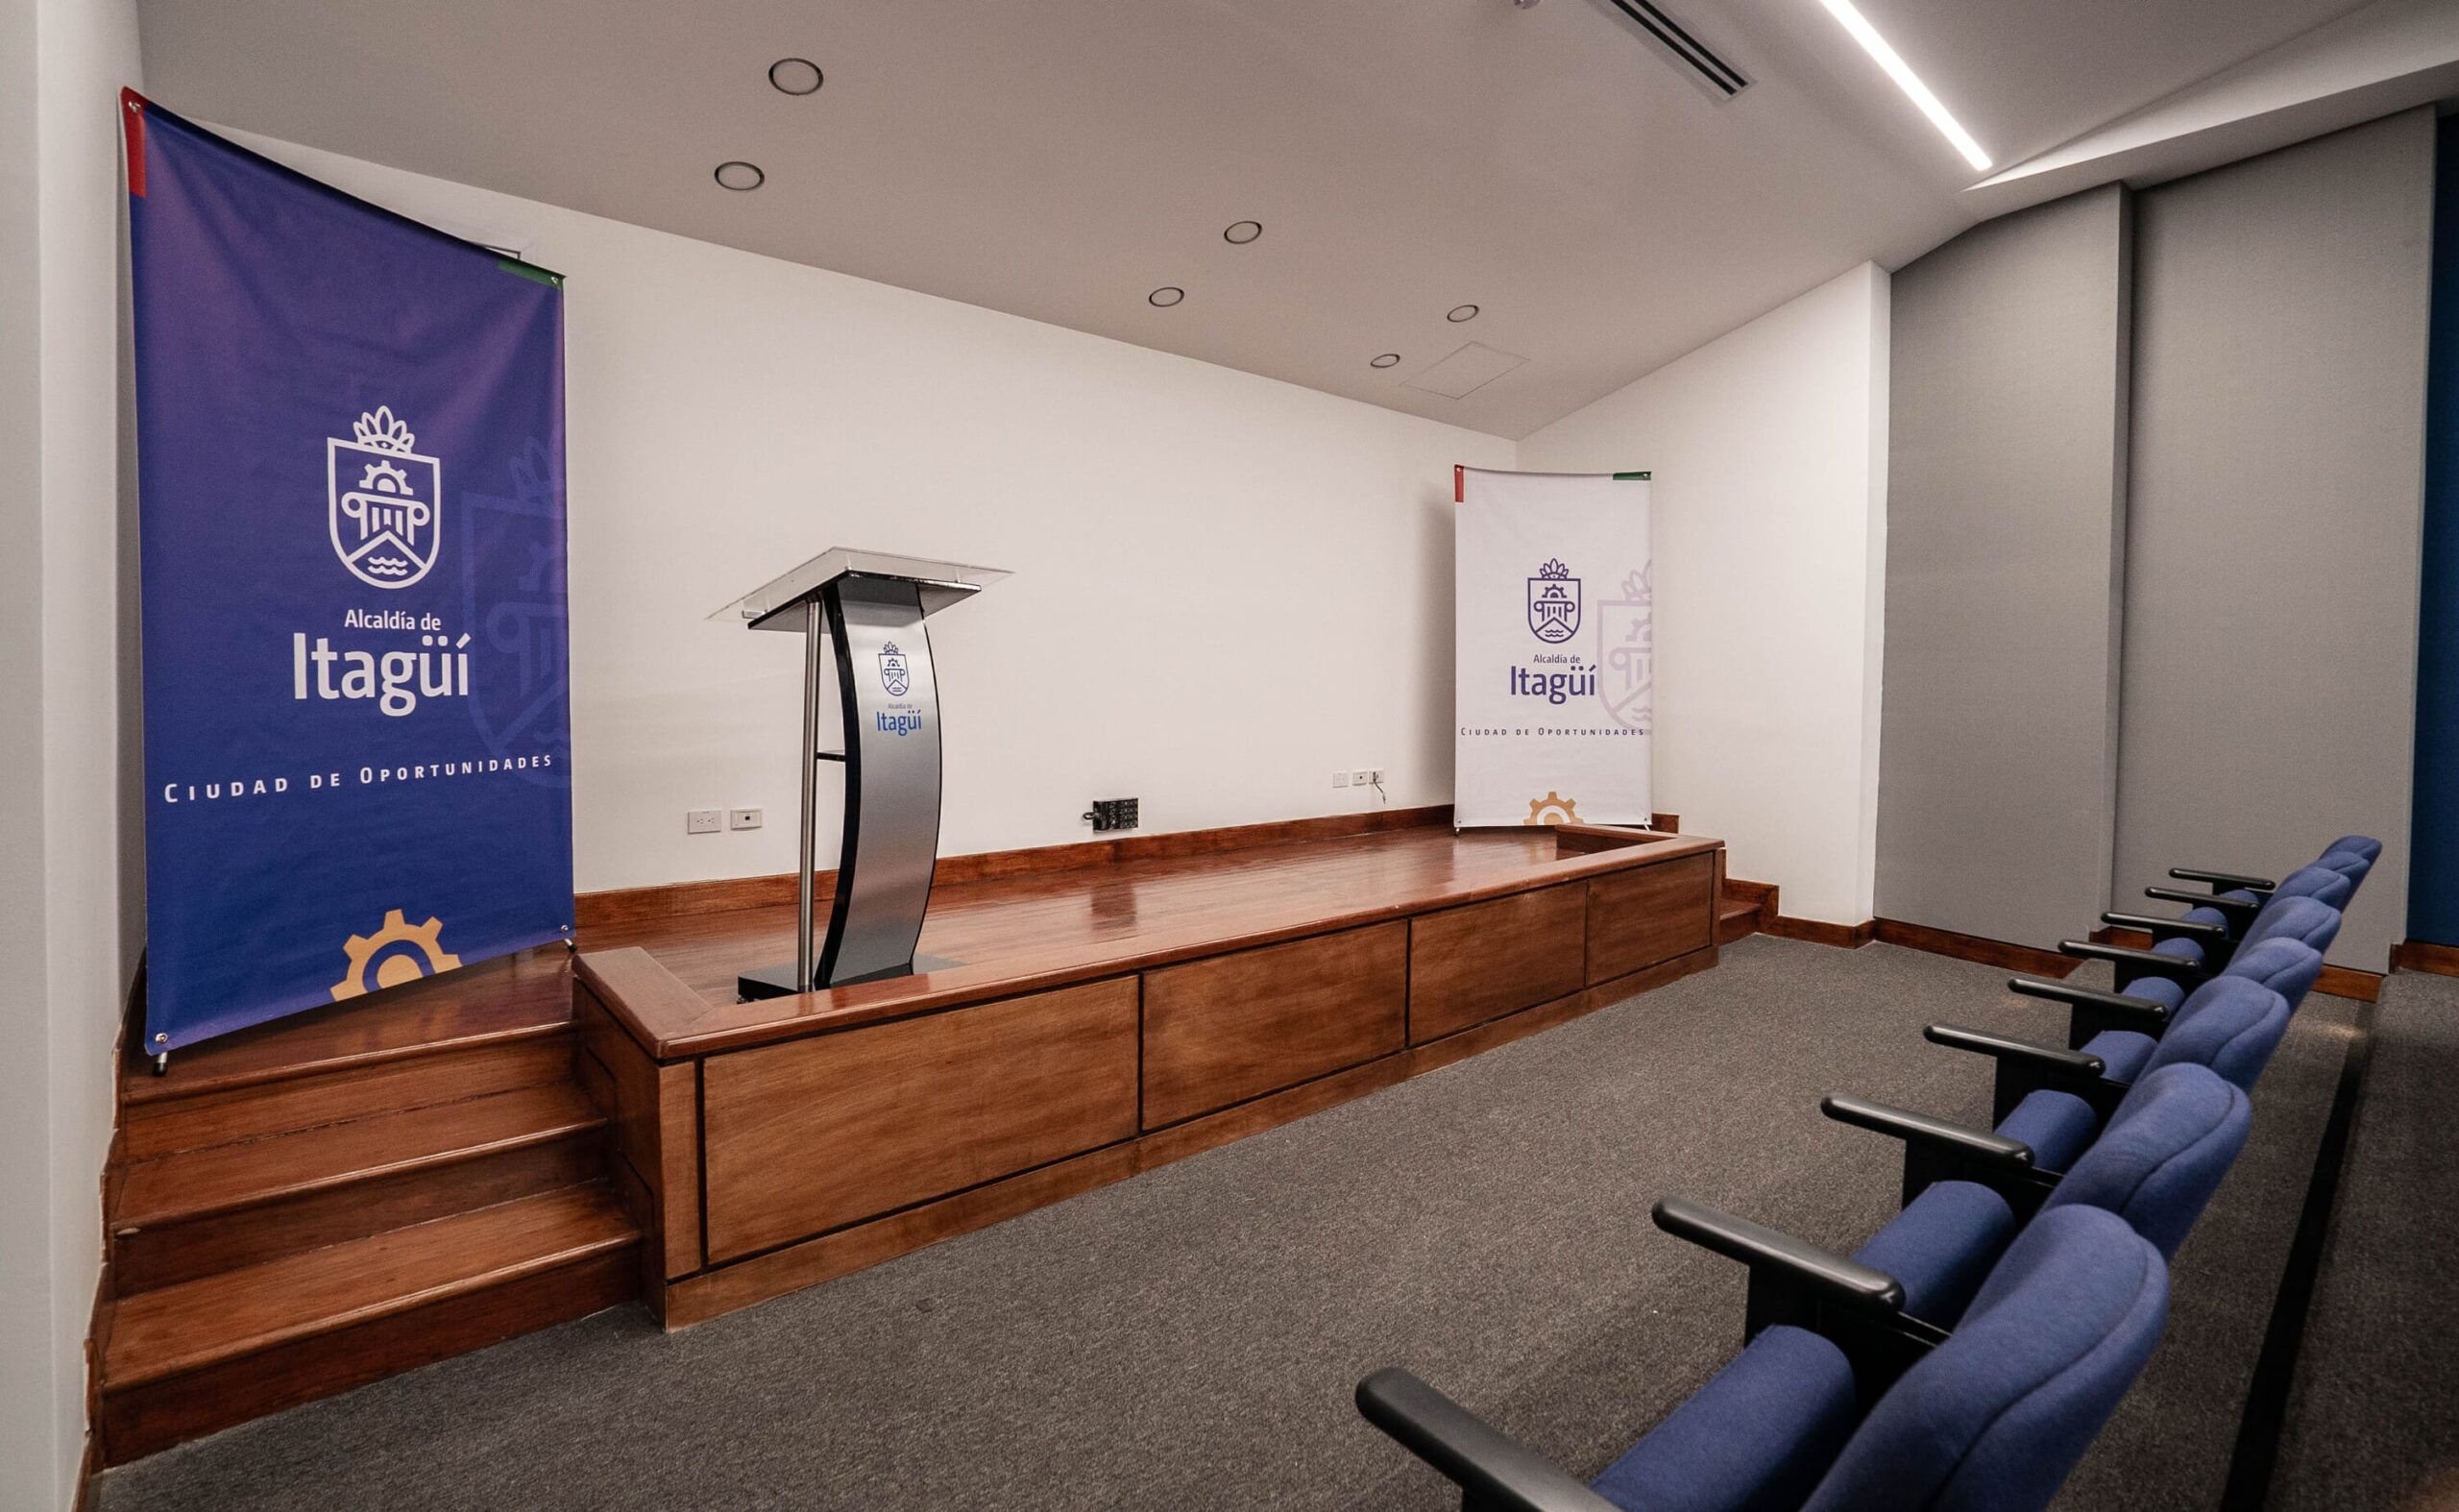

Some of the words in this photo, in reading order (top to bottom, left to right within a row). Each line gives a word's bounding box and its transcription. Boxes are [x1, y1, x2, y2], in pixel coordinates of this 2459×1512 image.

[344, 609, 416, 630] Alcaldía
[421, 613, 441, 631] de
[1533, 654, 1568, 664] Alcaldía
[1570, 654, 1581, 664] de
[293, 633, 471, 717] Itagüí
[1510, 665, 1596, 704] Itagüí
[876, 709, 922, 737] Itagüí
[1460, 727, 1508, 736] CIUDAD
[1538, 727, 1644, 736] OPORTUNIDADES
[164, 777, 287, 803] CIUDAD
[309, 772, 341, 789] DE
[360, 754, 552, 785] OPORTUNIDADES
